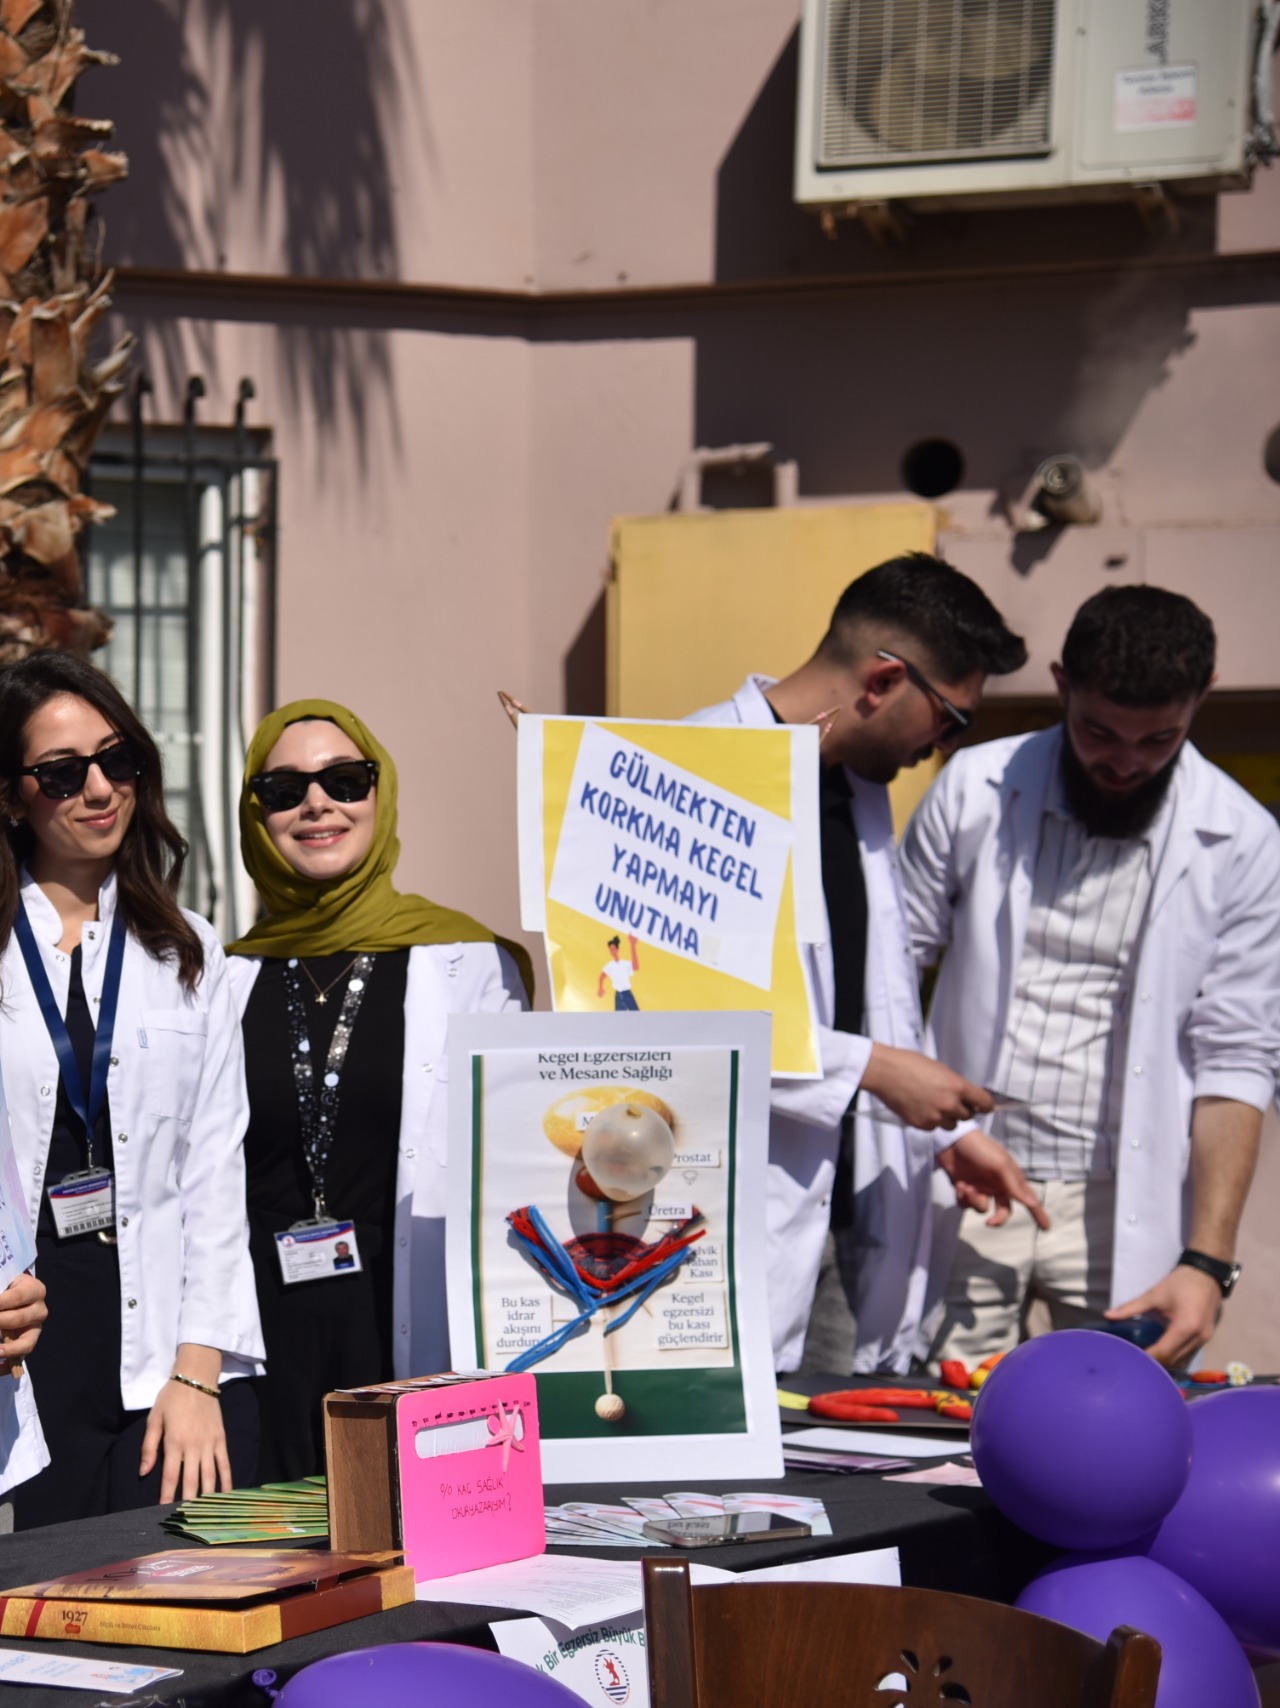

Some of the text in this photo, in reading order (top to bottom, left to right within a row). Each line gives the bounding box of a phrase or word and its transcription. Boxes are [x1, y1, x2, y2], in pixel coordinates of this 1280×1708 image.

[609, 749, 757, 849] GÜLMEKTEN
[580, 781, 764, 900] KORKMA KEGEL
[611, 842, 719, 922] YAPMAYI
[595, 882, 701, 957] UNUTMA
[538, 1051, 579, 1067] Kegel
[539, 1065, 673, 1082] ve Mesane Sağlığı
[501, 1296, 541, 1308] Bu kas
[671, 1292, 705, 1306] Kegel
[507, 1310, 536, 1321] idrar
[662, 1306, 715, 1319] egzersizi
[503, 1324, 542, 1336] akışını
[668, 1319, 711, 1330] bu kası
[657, 1332, 723, 1347] güçlendirir
[62, 1609, 88, 1626] 1927
[543, 1649, 560, 1672] Bir
[557, 1628, 601, 1660] Egzersiz
[600, 1625, 637, 1646] Büyük
